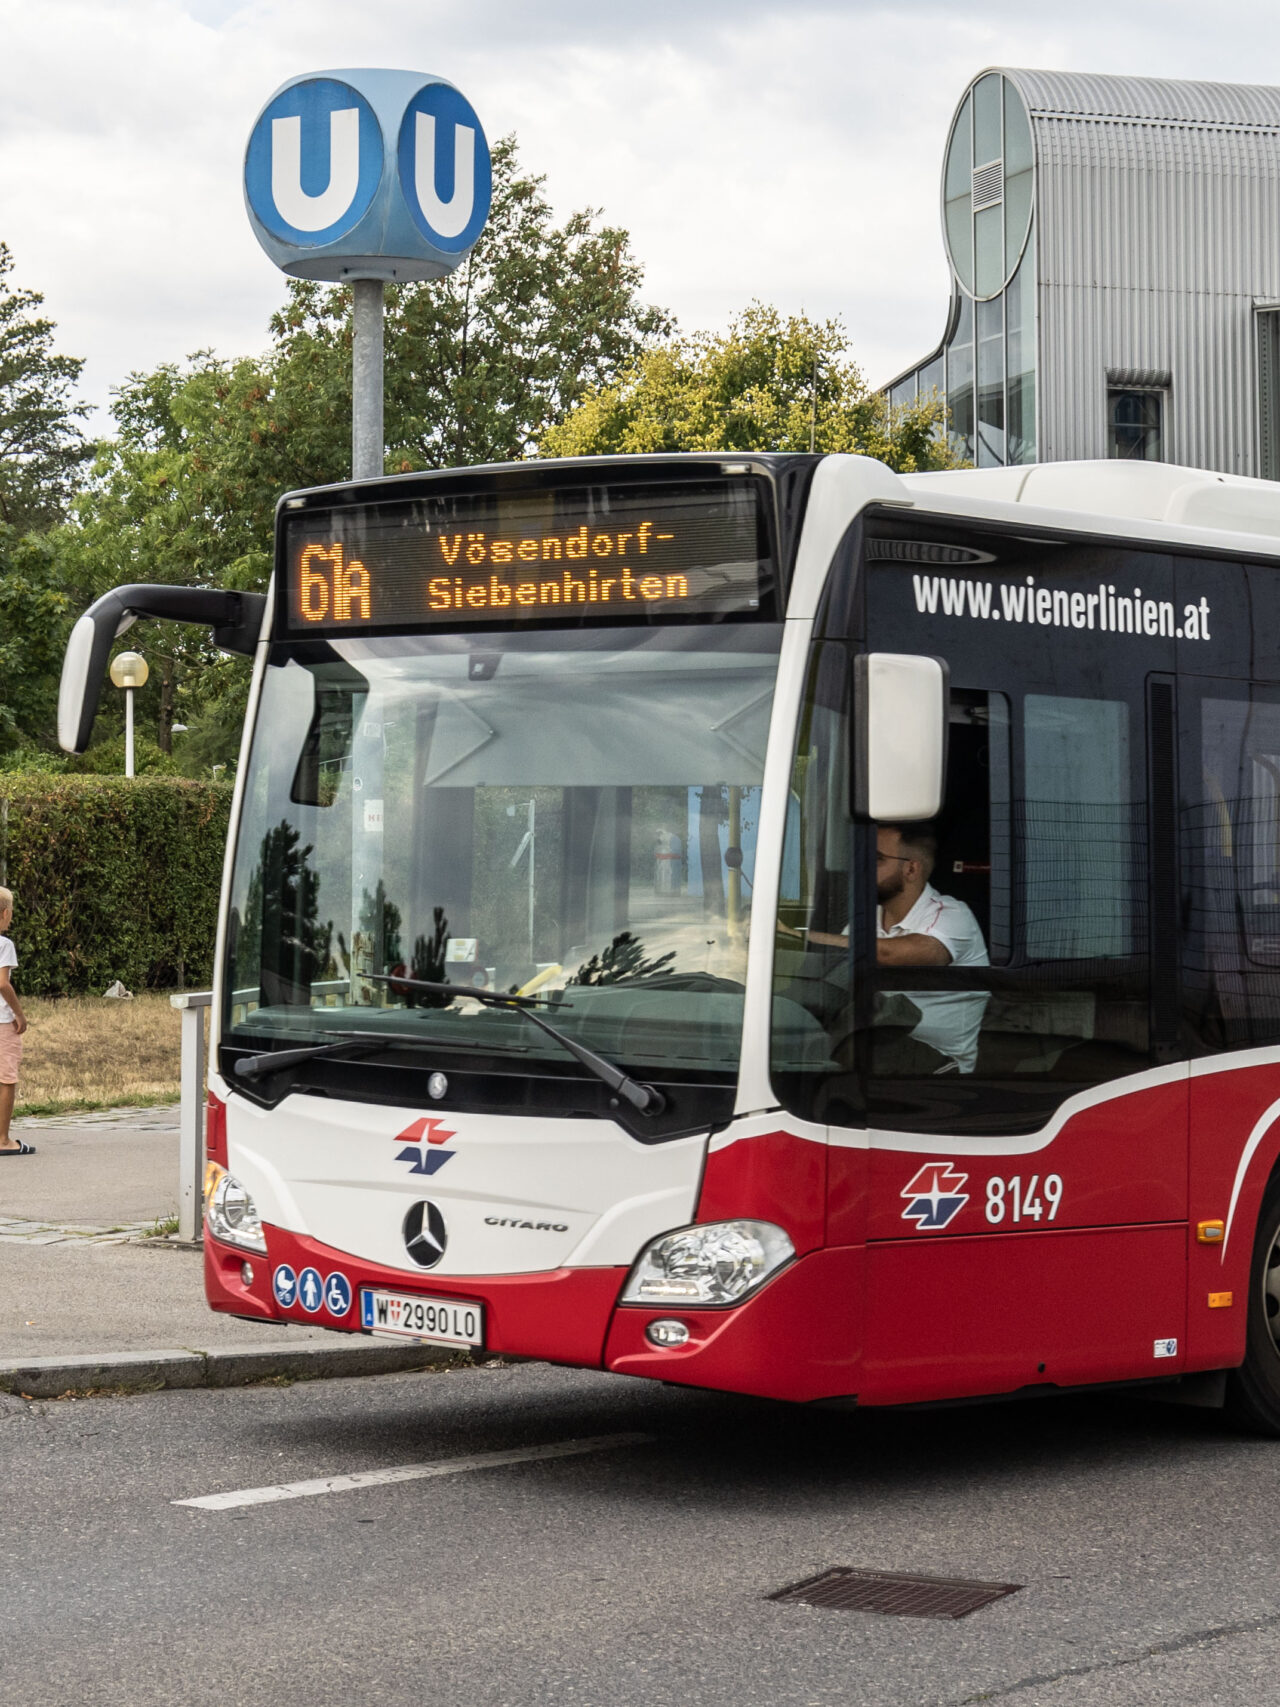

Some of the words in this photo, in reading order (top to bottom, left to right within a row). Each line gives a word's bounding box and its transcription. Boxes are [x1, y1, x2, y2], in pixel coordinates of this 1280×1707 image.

[271, 107, 360, 233] U
[414, 110, 476, 239] U
[438, 521, 675, 565] Vösendorf-
[300, 543, 371, 621] 61A
[428, 568, 688, 609] Siebenhirten
[912, 574, 1211, 641] www.wienerlinien.at
[984, 1173, 1064, 1224] 8149
[484, 1216, 569, 1233] CITARO
[376, 1298, 389, 1324] W
